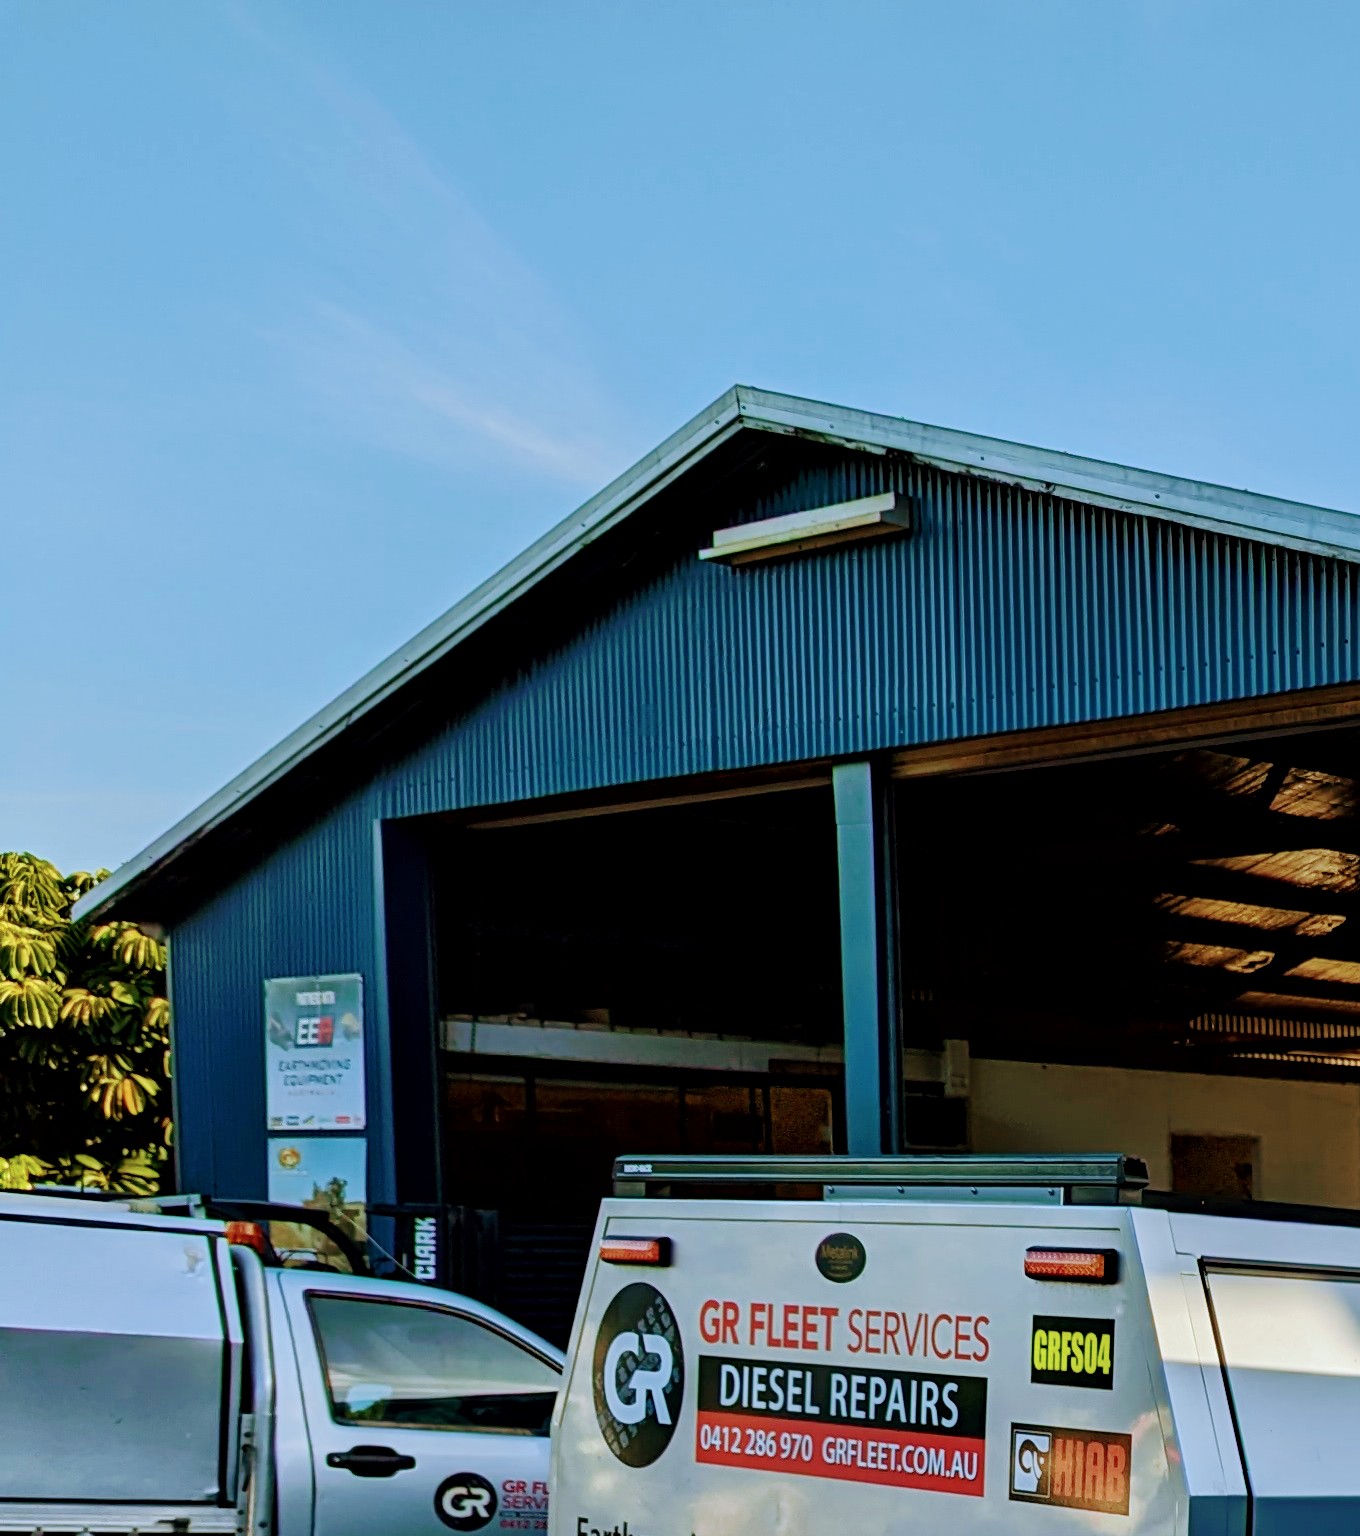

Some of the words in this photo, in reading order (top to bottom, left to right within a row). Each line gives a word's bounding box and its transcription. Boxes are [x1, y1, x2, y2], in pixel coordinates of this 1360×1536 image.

[415, 1216, 436, 1281] CLARK
[700, 1300, 739, 1344] GR
[749, 1303, 838, 1351] FLEET
[847, 1308, 990, 1362] SERVICES
[1033, 1328, 1112, 1376] GRFS04
[603, 1331, 673, 1425] GR
[720, 1364, 820, 1415] DIESEL
[830, 1376, 959, 1429] REPAIRS
[700, 1424, 741, 1455] 0412
[745, 1429, 776, 1459] 286
[780, 1433, 813, 1462] 970
[822, 1436, 978, 1482] GRFLEET.COM.AU
[1054, 1439, 1126, 1500] HIAB
[442, 1486, 491, 1518] GR
[502, 1480, 526, 1493] GR
